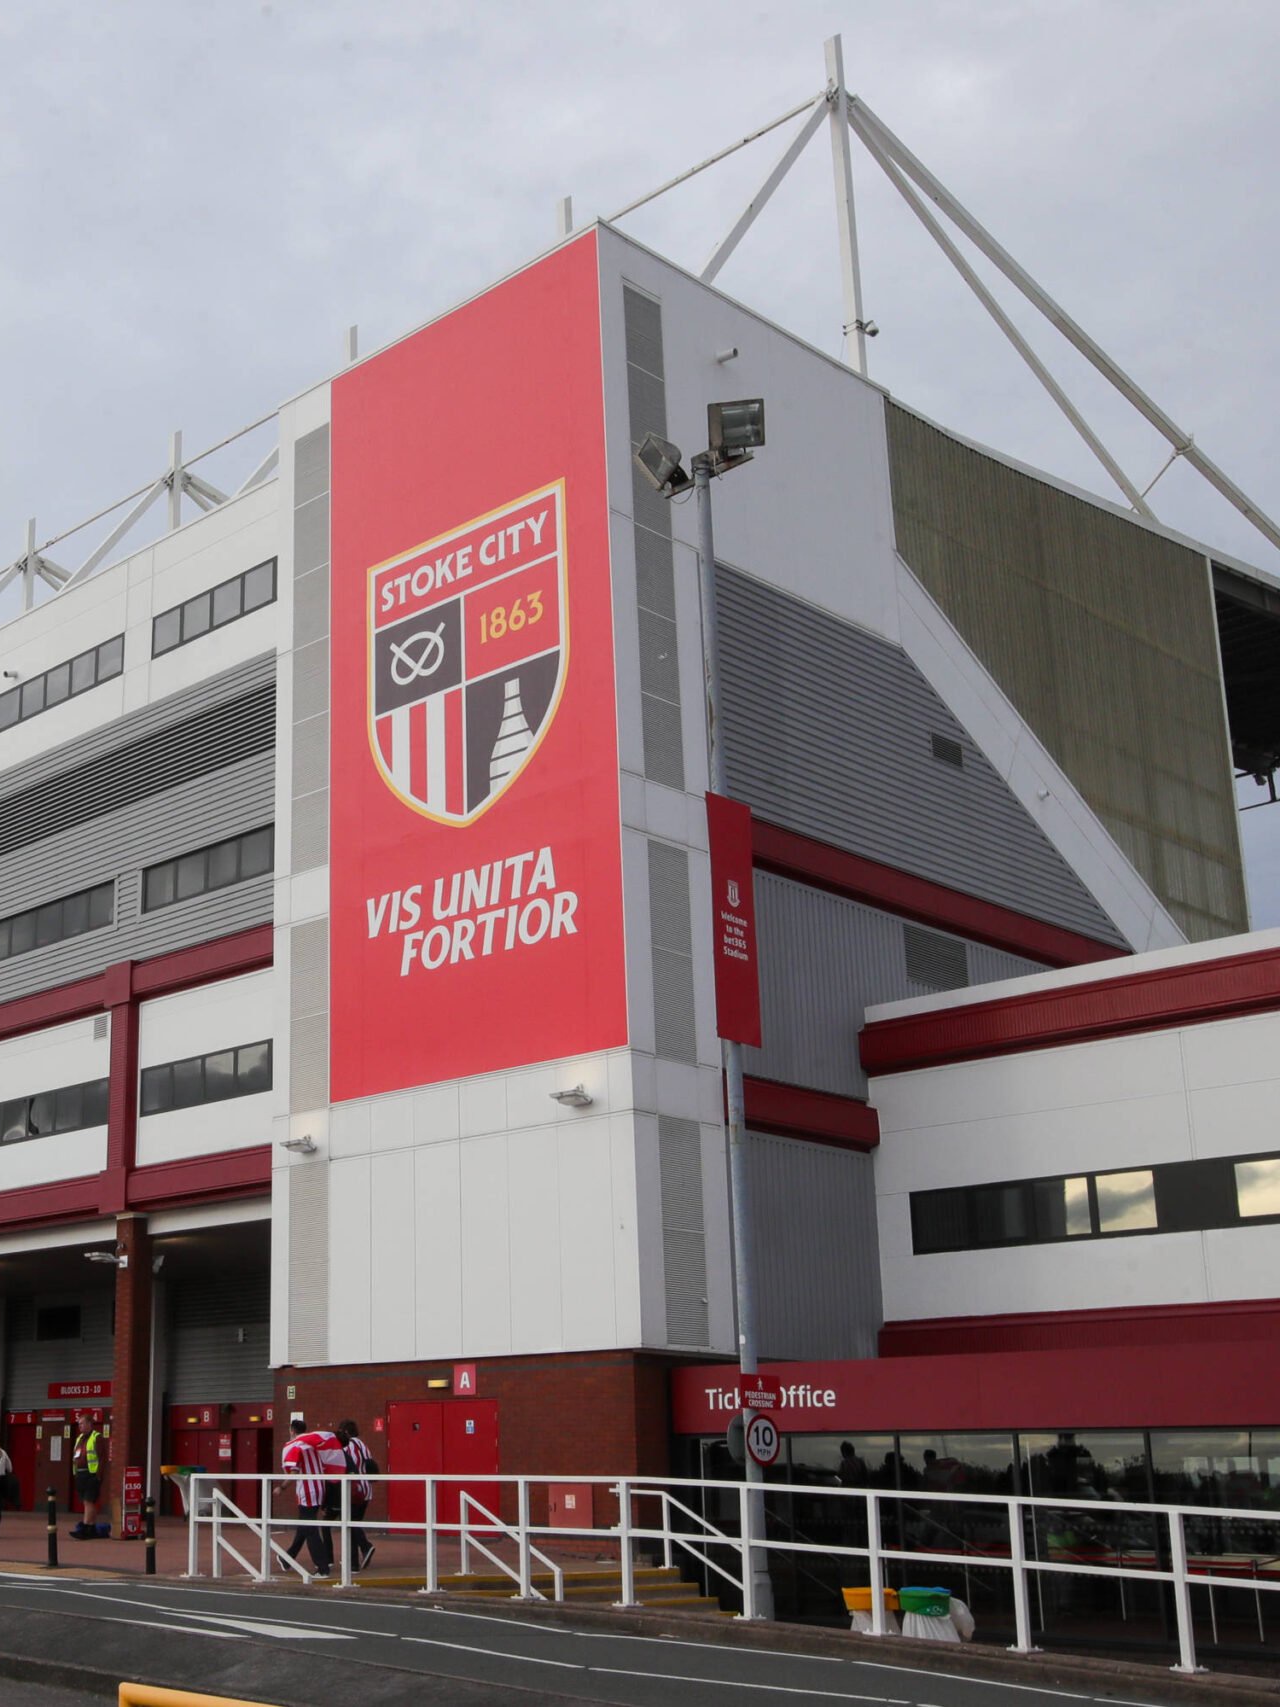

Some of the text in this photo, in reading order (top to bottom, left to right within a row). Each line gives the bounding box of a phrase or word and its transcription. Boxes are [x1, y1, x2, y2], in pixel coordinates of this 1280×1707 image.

[381, 510, 549, 613] STOKE CITY
[479, 590, 544, 645] 1863
[366, 846, 557, 939] VIS UNITA
[721, 910, 748, 927] Welcome
[399, 890, 579, 977] FORTIOR
[726, 924, 744, 937] to the
[723, 934, 747, 950] bet365
[723, 945, 749, 961] Stadium
[460, 1371, 471, 1389] A
[60, 1385, 81, 1395] BLOCKS
[82, 1385, 90, 1394] 13
[93, 1384, 102, 1394] 10
[745, 1390, 777, 1400] PEDESTRIAN
[705, 1387, 741, 1410] Tick
[748, 1399, 774, 1408] CROSSING
[10, 1414, 16, 1424] 7
[753, 1425, 774, 1447] 10
[757, 1448, 771, 1456] MPH
